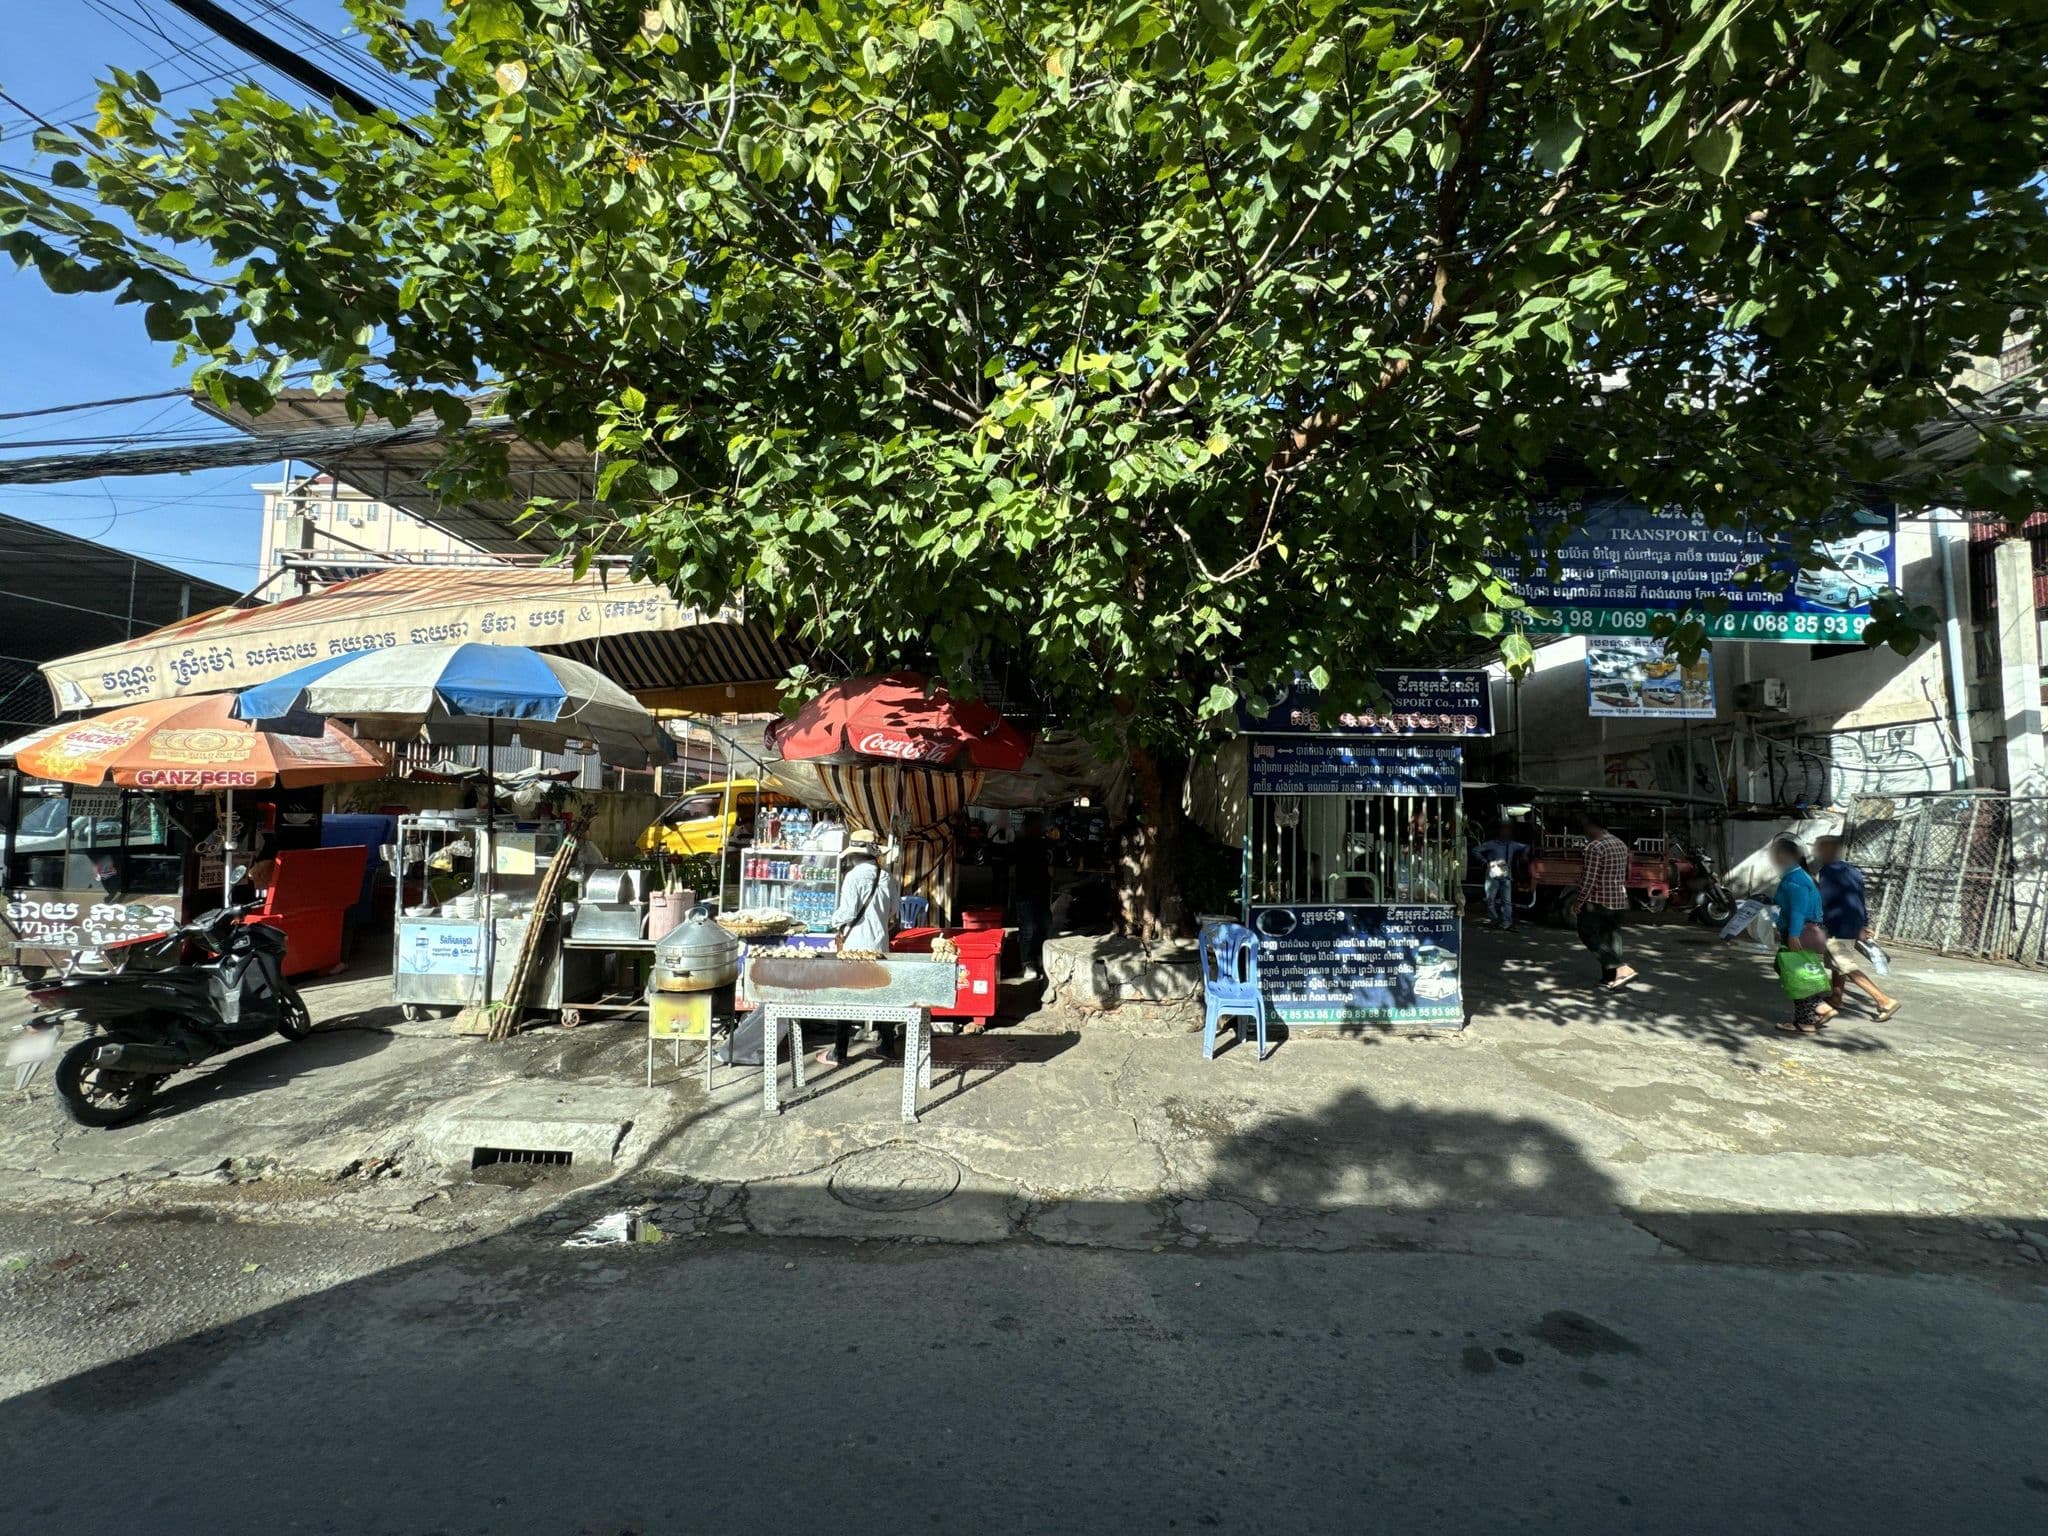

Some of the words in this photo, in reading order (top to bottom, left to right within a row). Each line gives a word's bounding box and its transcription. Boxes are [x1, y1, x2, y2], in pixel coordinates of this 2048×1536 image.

[1608, 529, 1710, 541] TRANSPORT
[1570, 611, 1593, 628] 98
[1611, 611, 1647, 629] 069
[1752, 615, 1788, 632] 088
[1794, 615, 1818, 633] 85
[1823, 616, 1848, 633] 93
[170, 646, 235, 686] ស្រីម៉ៅ
[245, 642, 318, 667] លក់បាយ
[410, 621, 469, 644] បាយឆា
[481, 611, 516, 634] មីឆា
[528, 609, 565, 628] បបរ
[577, 606, 593, 623] &
[1397, 675, 1480, 697] ដឹកអ្នកដំណើរ
[1457, 698, 1482, 708] LTD.
[137, 770, 257, 786] GANZBERG
[1435, 925, 1456, 933] LTD.
[1290, 1010, 1302, 1019] 85
[1303, 1010, 1315, 1019] 93
[1316, 1010, 1328, 1019] 98
[1336, 1010, 1353, 1019] 069
[1355, 1010, 1366, 1018] 89
[1368, 1010, 1380, 1018] 88
[1382, 1009, 1393, 1018] 78
[1400, 1009, 1416, 1018] 088
[1418, 1008, 1430, 1017] 85
[1431, 1008, 1443, 1017] 93
